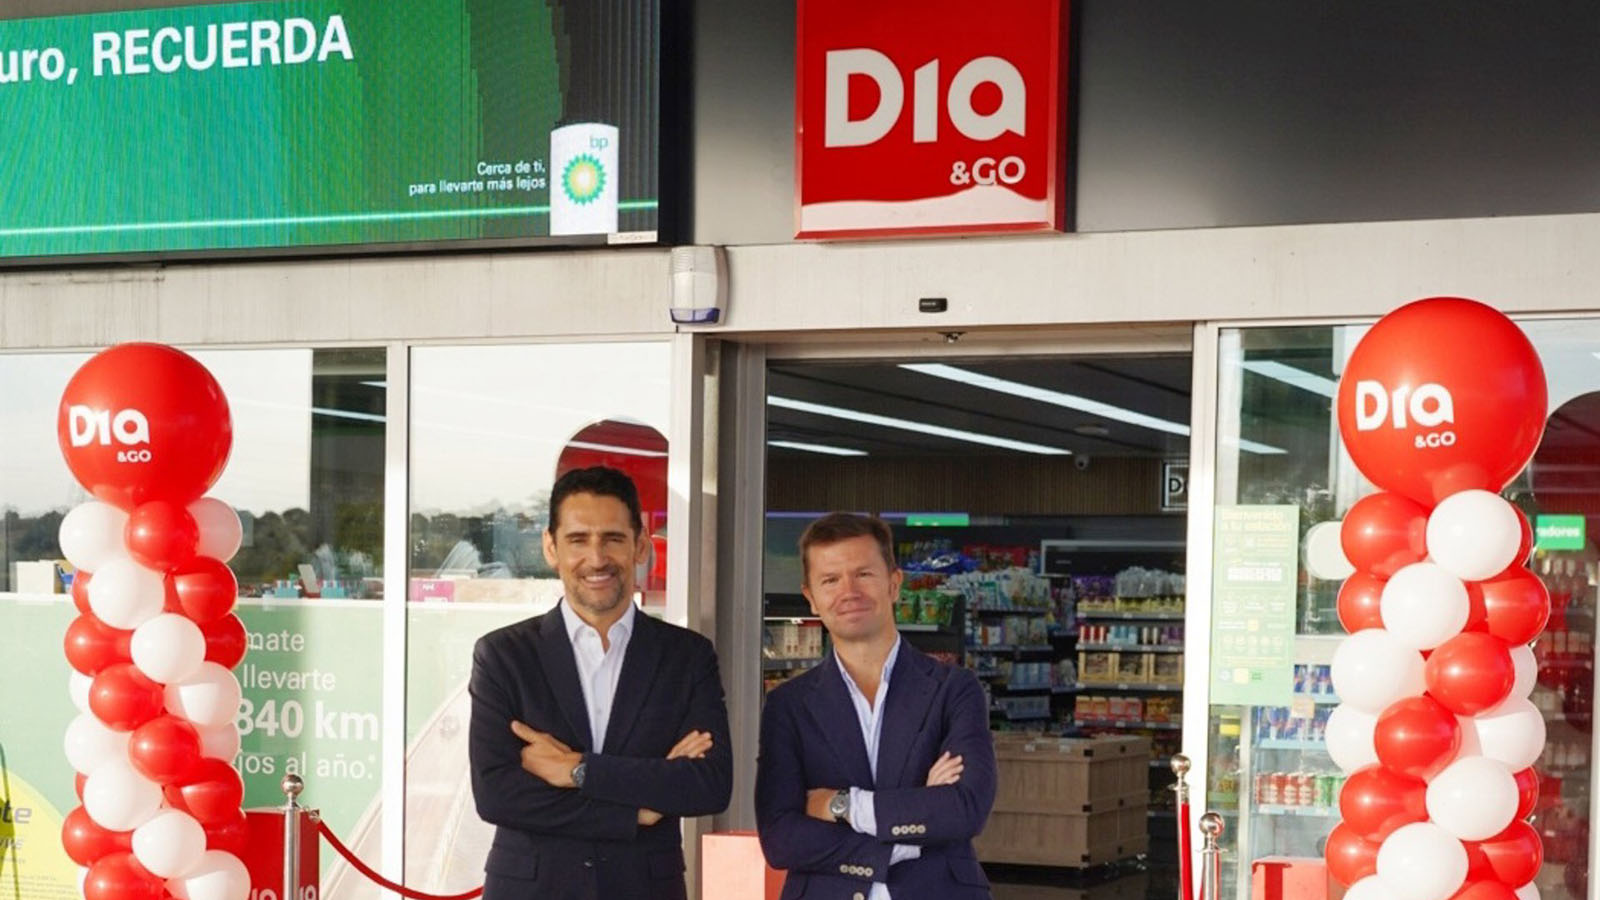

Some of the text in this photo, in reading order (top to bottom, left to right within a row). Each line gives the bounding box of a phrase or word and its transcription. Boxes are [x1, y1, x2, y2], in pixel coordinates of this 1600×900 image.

[0, 15, 354, 85] uro, RECUERDA
[589, 134, 609, 150] bp
[477, 161, 512, 176] Cerca
[514, 160, 530, 174] de
[949, 155, 1026, 185] &GO
[409, 175, 546, 196] para llevarte más lejos
[1414, 431, 1456, 448] &GO
[117, 450, 151, 462] &GO
[243, 664, 336, 690] llevarte
[237, 698, 378, 742] 840 km
[235, 754, 275, 776] jos
[285, 751, 306, 776] al
[0, 800, 32, 824] te
